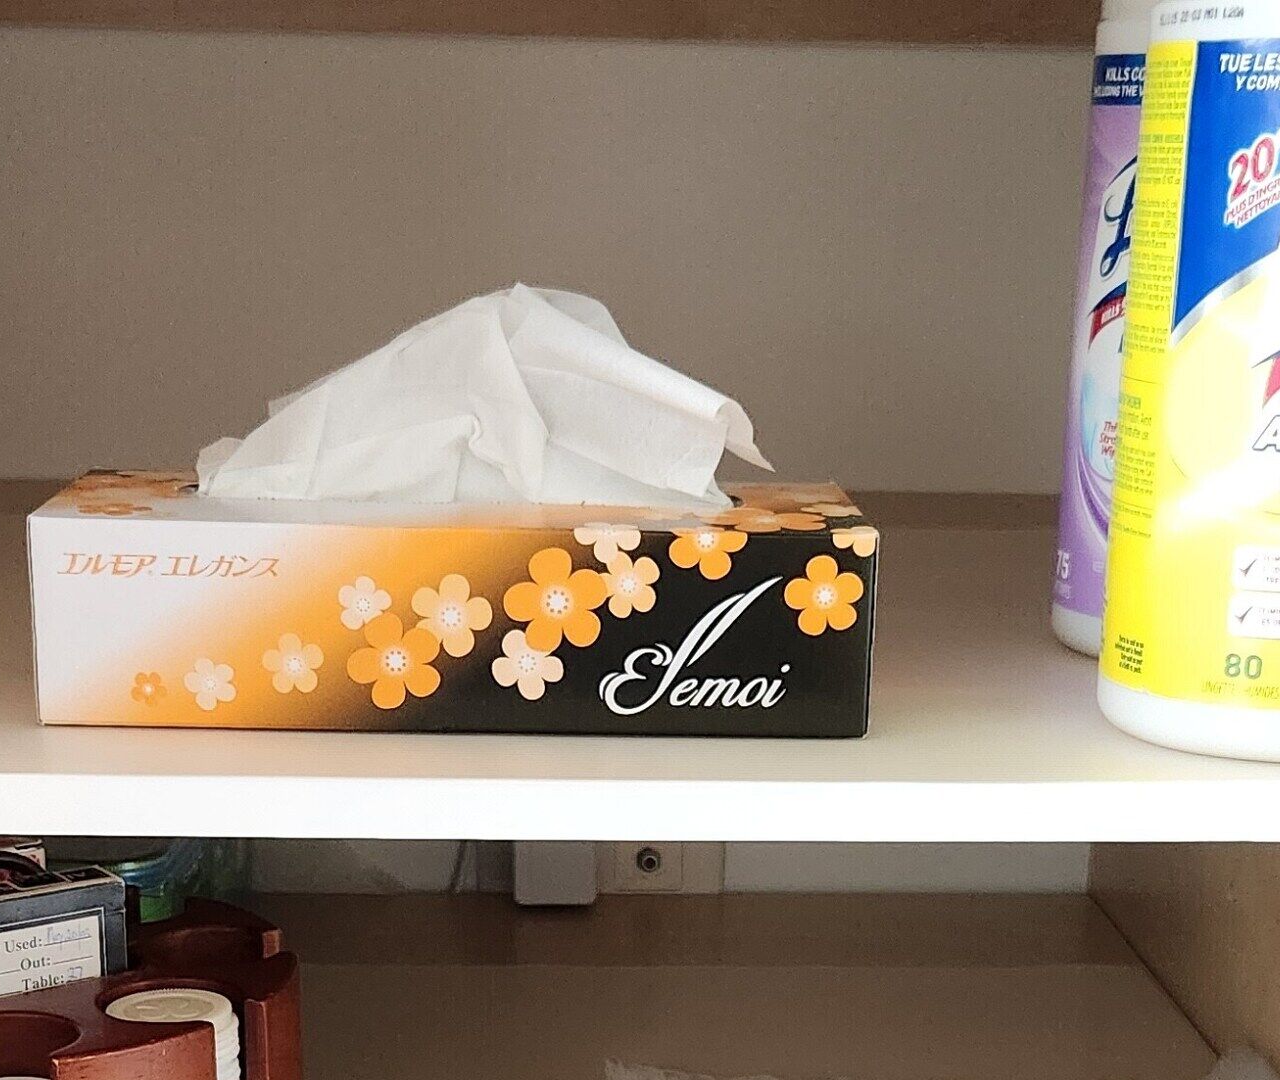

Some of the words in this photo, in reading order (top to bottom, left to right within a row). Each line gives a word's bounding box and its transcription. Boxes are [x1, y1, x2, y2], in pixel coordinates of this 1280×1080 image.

[1220, 53, 1253, 73] TUE
[1105, 67, 1130, 82] KILLS
[1236, 74, 1247, 91] Y
[1121, 85, 1138, 97] THE
[1226, 202, 1246, 223] PLUS
[57, 552, 157, 578] エルモア
[160, 554, 280, 578] エレガンス
[1056, 549, 1070, 579] 75
[1223, 653, 1263, 680] 80
[4, 936, 43, 953] Used:
[20, 956, 51, 971] Out:
[22, 973, 65, 992] Table:
